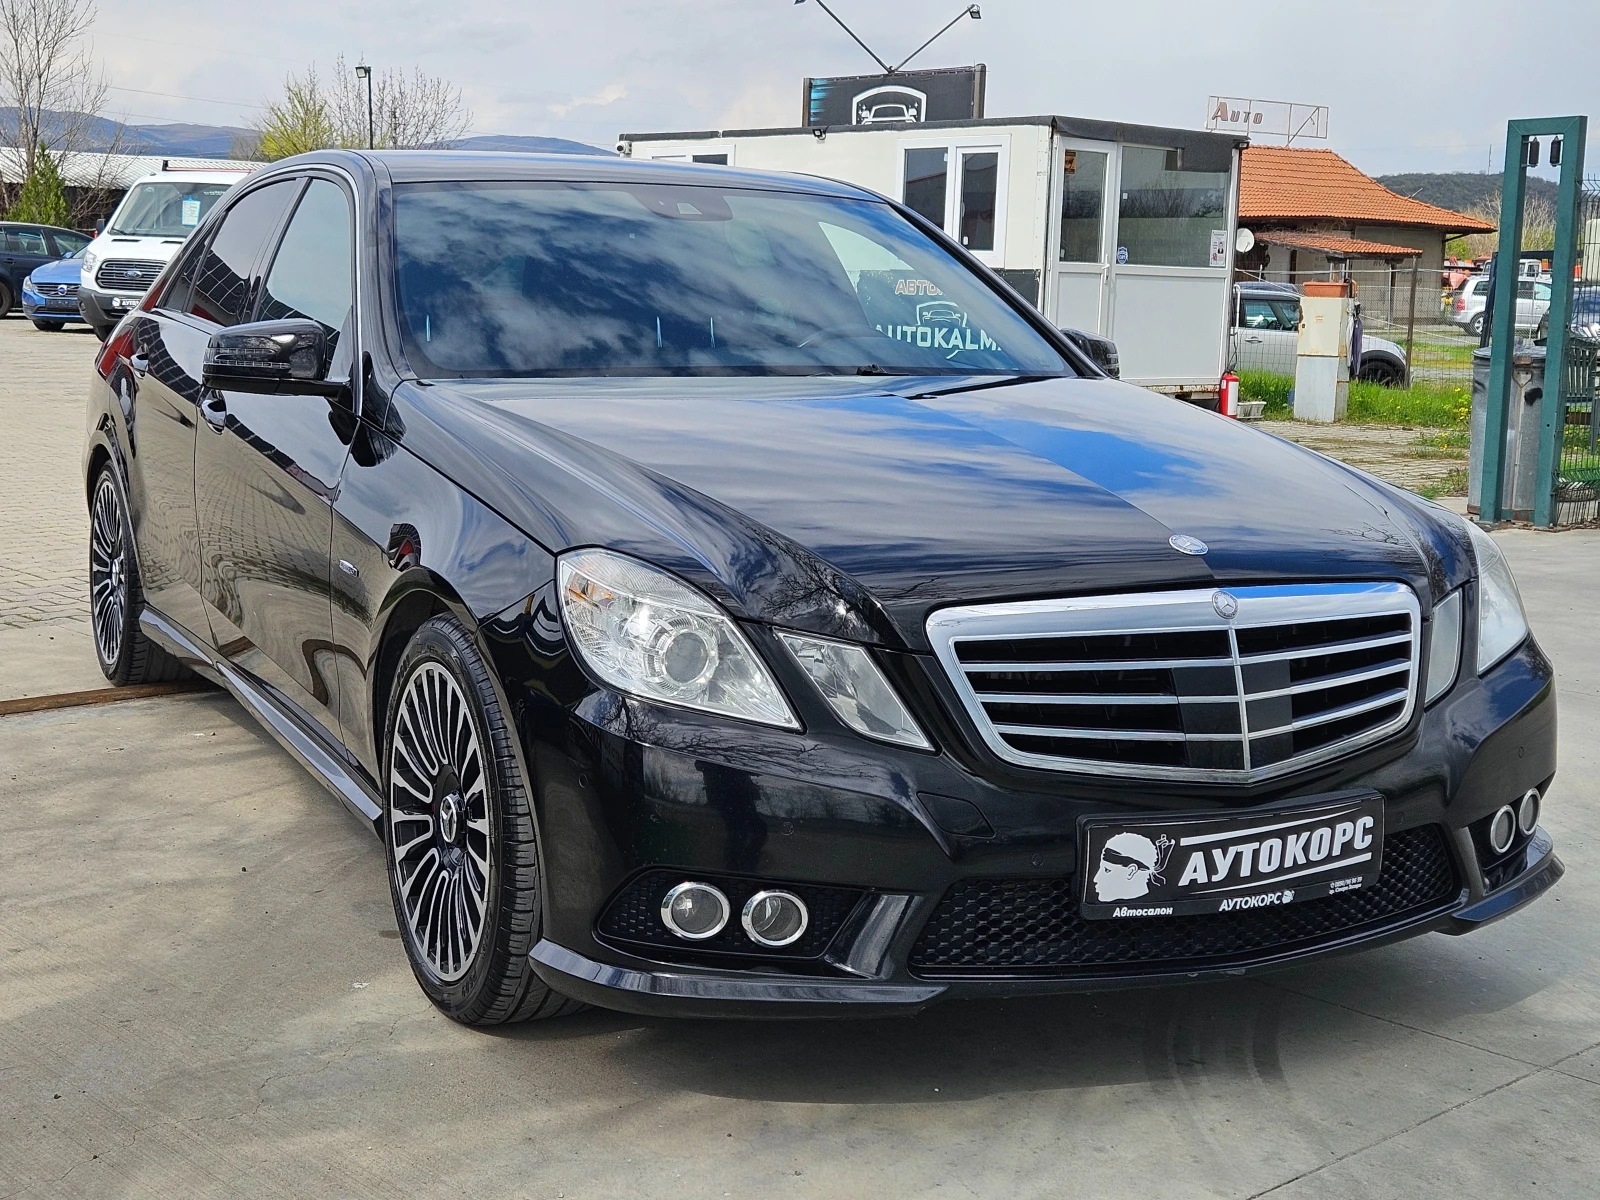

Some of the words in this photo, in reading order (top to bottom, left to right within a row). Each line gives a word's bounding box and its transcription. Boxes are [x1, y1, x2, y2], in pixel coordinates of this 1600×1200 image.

[1178, 816, 1374, 886] АУТОКОРС
[1112, 906, 1173, 918] Автосалон
[1218, 892, 1282, 912] АУТОКОРС
